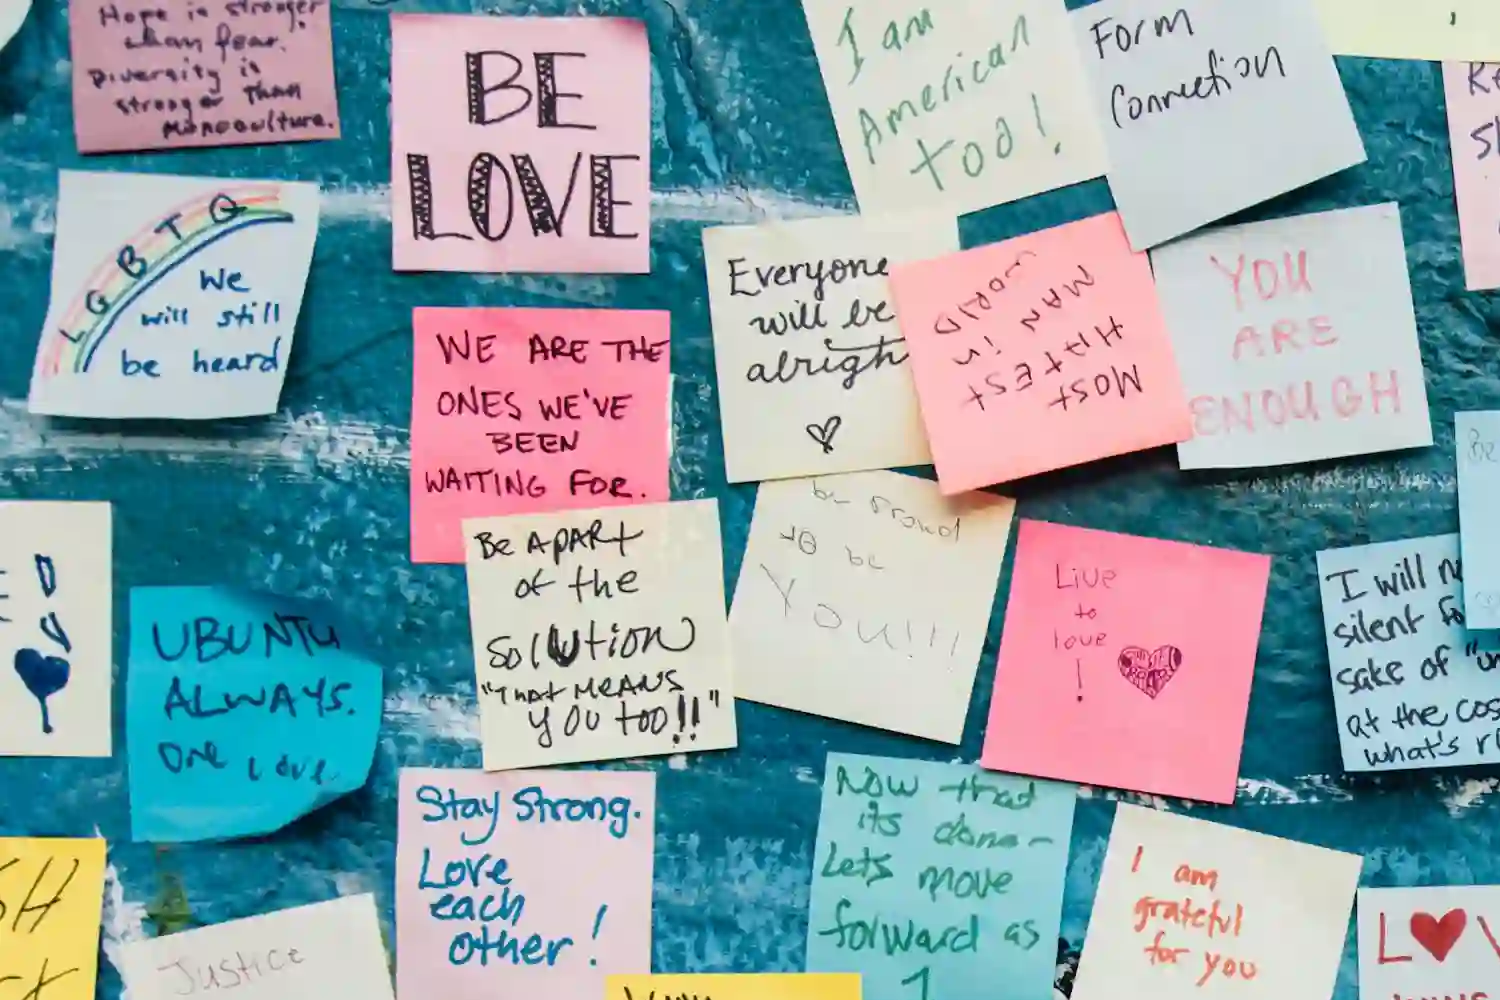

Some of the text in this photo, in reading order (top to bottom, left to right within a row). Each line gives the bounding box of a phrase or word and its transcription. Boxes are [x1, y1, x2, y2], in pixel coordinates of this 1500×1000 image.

[465, 50, 597, 130] BE
[859, 14, 1030, 165] American
[406, 152, 640, 241] LOVE
[199, 267, 250, 292] We
[726, 256, 889, 297] Everyone
[1210, 251, 1313, 313] YOU
[141, 303, 280, 327] will still
[749, 299, 896, 335] will be
[121, 338, 279, 377] be heard
[436, 334, 668, 365] WE ARE THE
[1233, 317, 1340, 360] ARE
[437, 387, 634, 420] ONES WE'VE
[486, 432, 578, 453] BEEN
[424, 469, 547, 502] WAITING
[515, 564, 639, 602] of the
[1055, 564, 1117, 589] Live
[1326, 555, 1428, 604] I will
[1074, 605, 1097, 620] to
[1334, 611, 1425, 647] silent
[152, 613, 340, 661] UBUNTU
[1053, 630, 1106, 650] love
[1337, 645, 1452, 695] sake of
[1346, 709, 1379, 739] at
[1392, 698, 1448, 727] the
[416, 787, 640, 844] Stay Strong.
[419, 850, 512, 889] Love
[919, 867, 1013, 901] move
[1174, 862, 1218, 892] am
[430, 887, 526, 925] each
[1133, 895, 1244, 937] grateful
[818, 899, 1040, 953] forward as
[156, 946, 304, 996] Justice
[1145, 933, 1257, 987] for you
